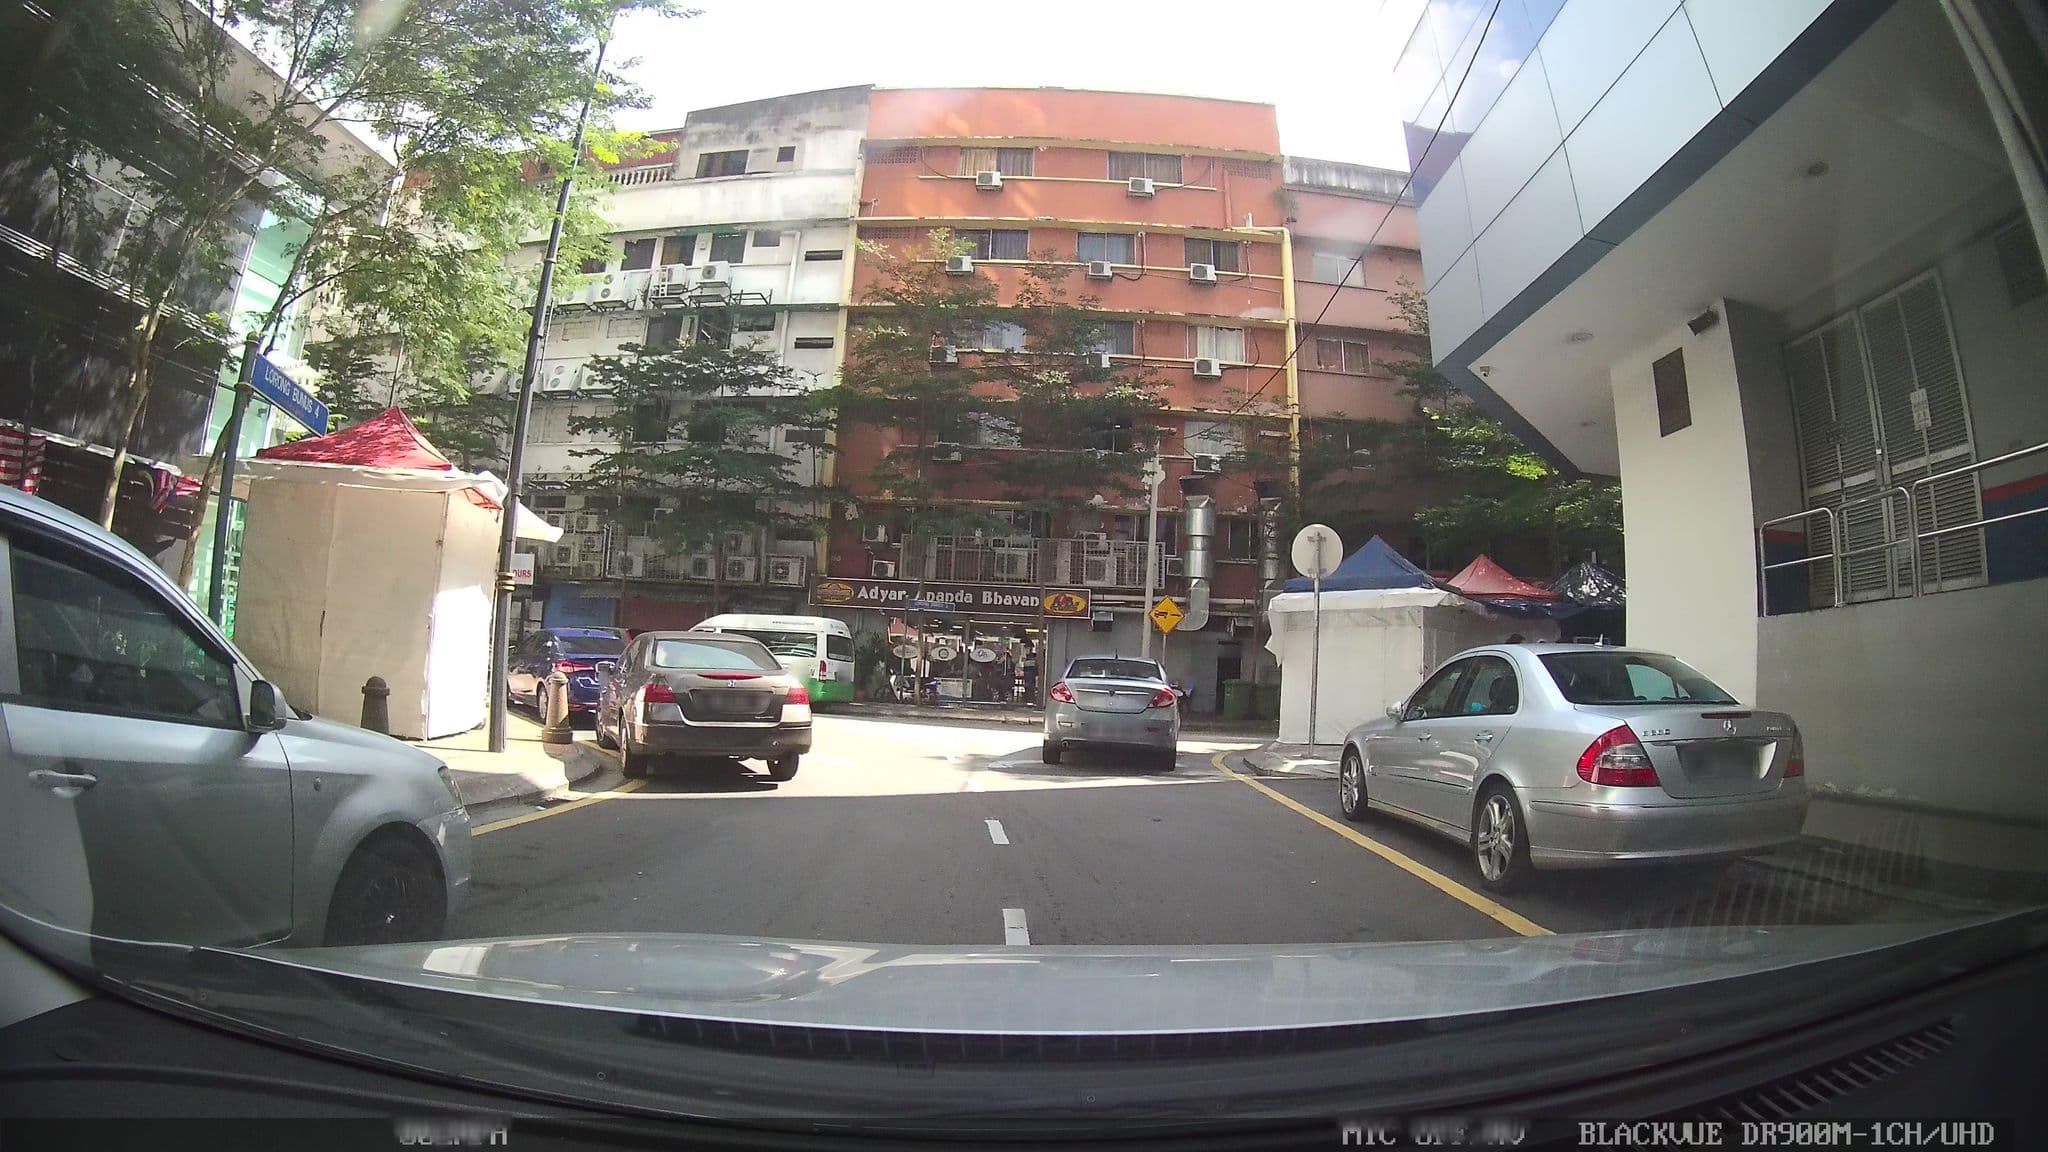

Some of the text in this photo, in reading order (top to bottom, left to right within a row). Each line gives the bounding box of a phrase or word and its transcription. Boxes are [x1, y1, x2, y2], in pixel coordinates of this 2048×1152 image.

[265, 366, 321, 419] LORONG BUNUS 4
[857, 585, 906, 602] Adyar
[982, 591, 1040, 607] Bhavan
